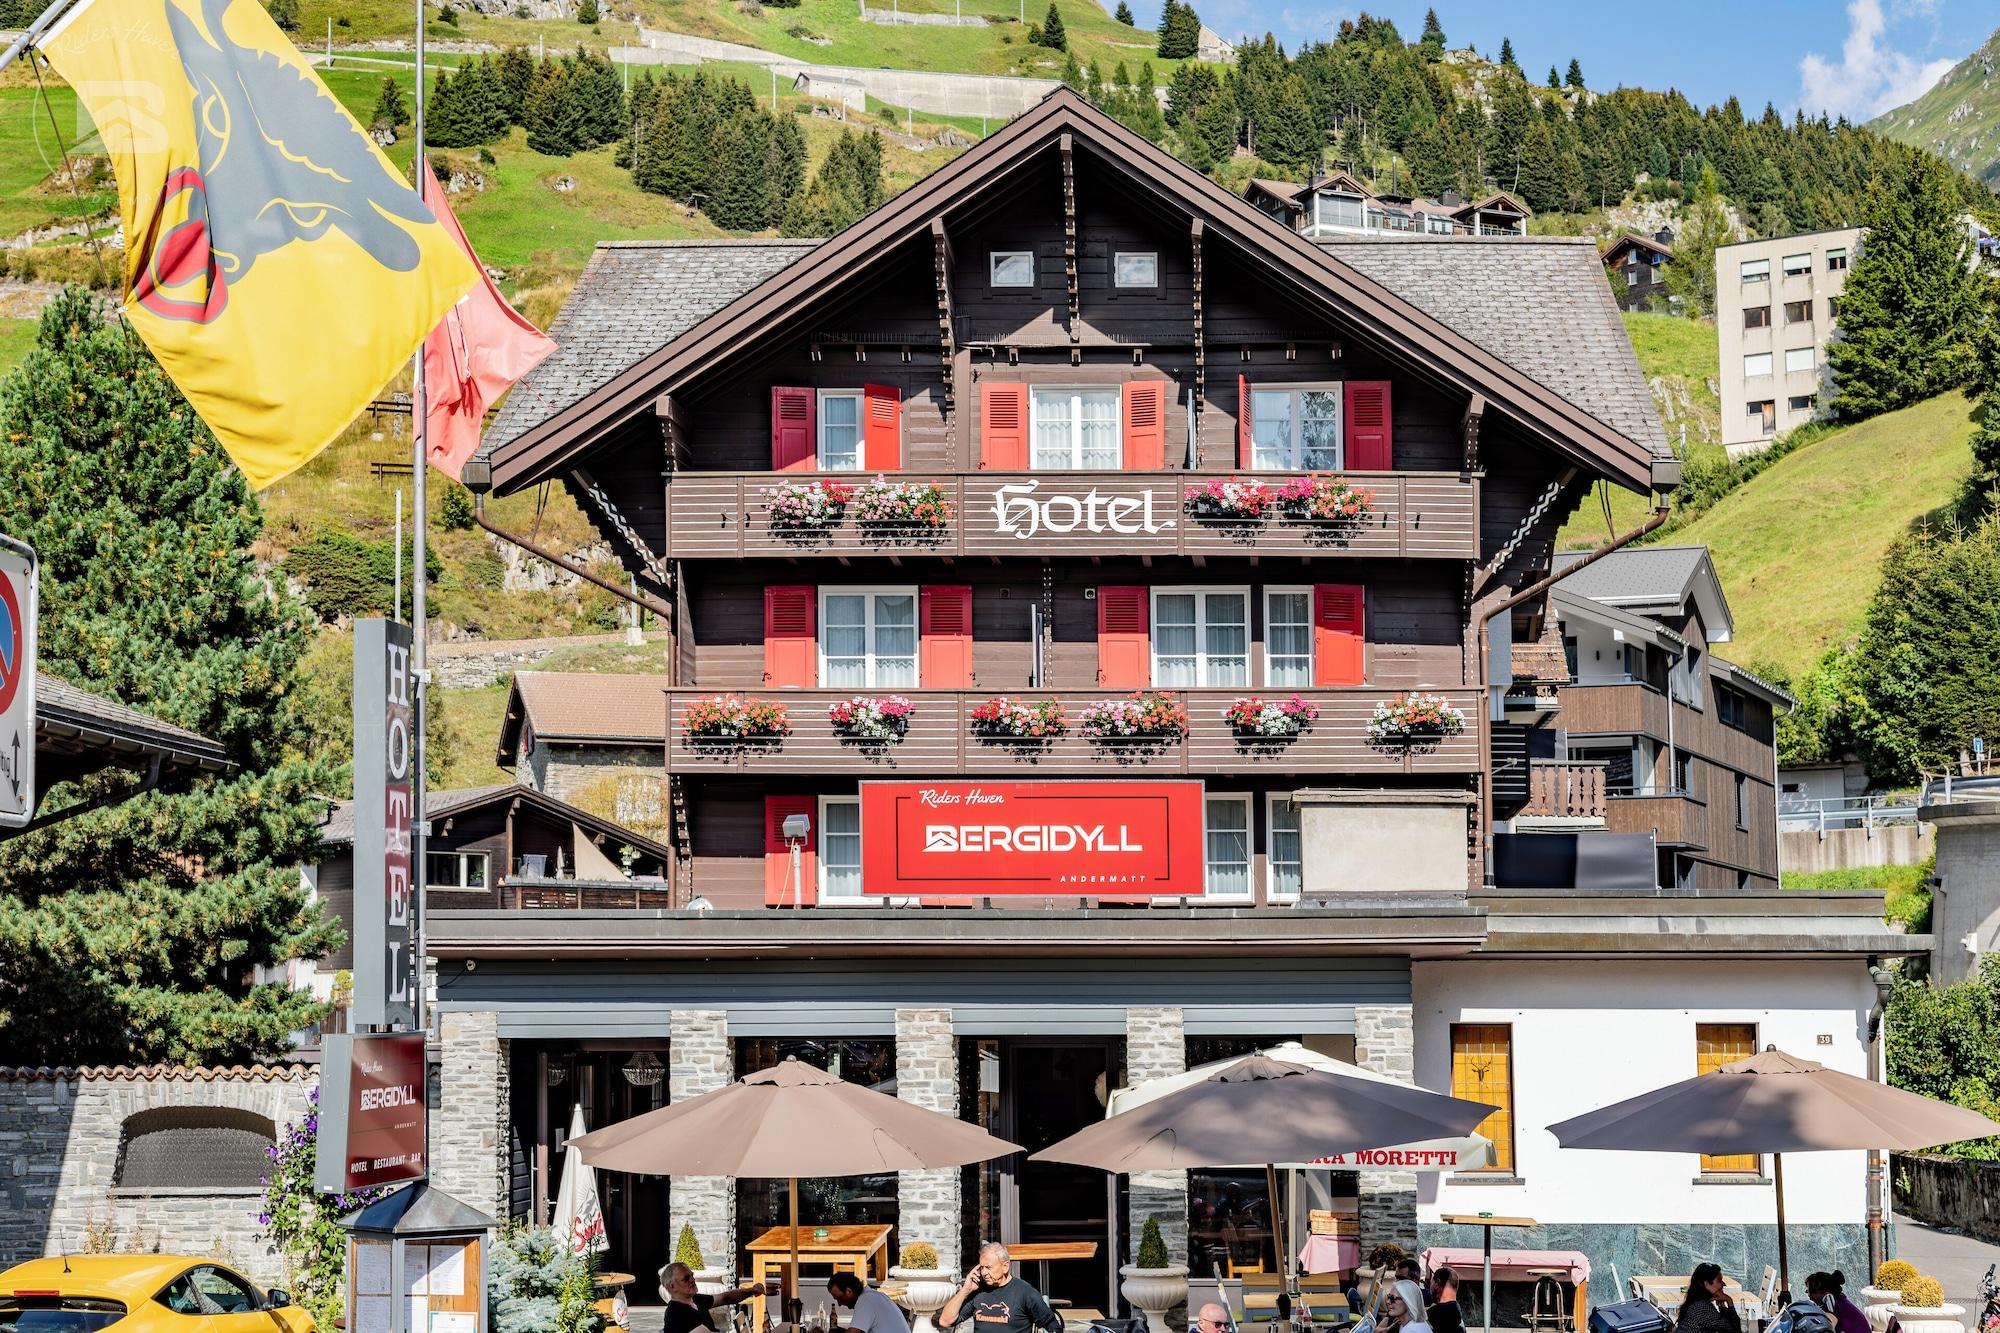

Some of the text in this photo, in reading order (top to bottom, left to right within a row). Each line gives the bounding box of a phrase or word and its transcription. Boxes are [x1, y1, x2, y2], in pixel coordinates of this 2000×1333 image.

[990, 479, 1176, 539] Hotel
[919, 789, 1005, 808] Riders Haven
[387, 643, 409, 1002] HOTEL
[922, 825, 1143, 852] BERGIDYLL
[1820, 1035, 1830, 1044] 39
[360, 1084, 416, 1111] BERGIDYLL
[351, 1152, 421, 1174] HOTEL RESTAURANT BAR
[1355, 1150, 1457, 1166] MORETTI
